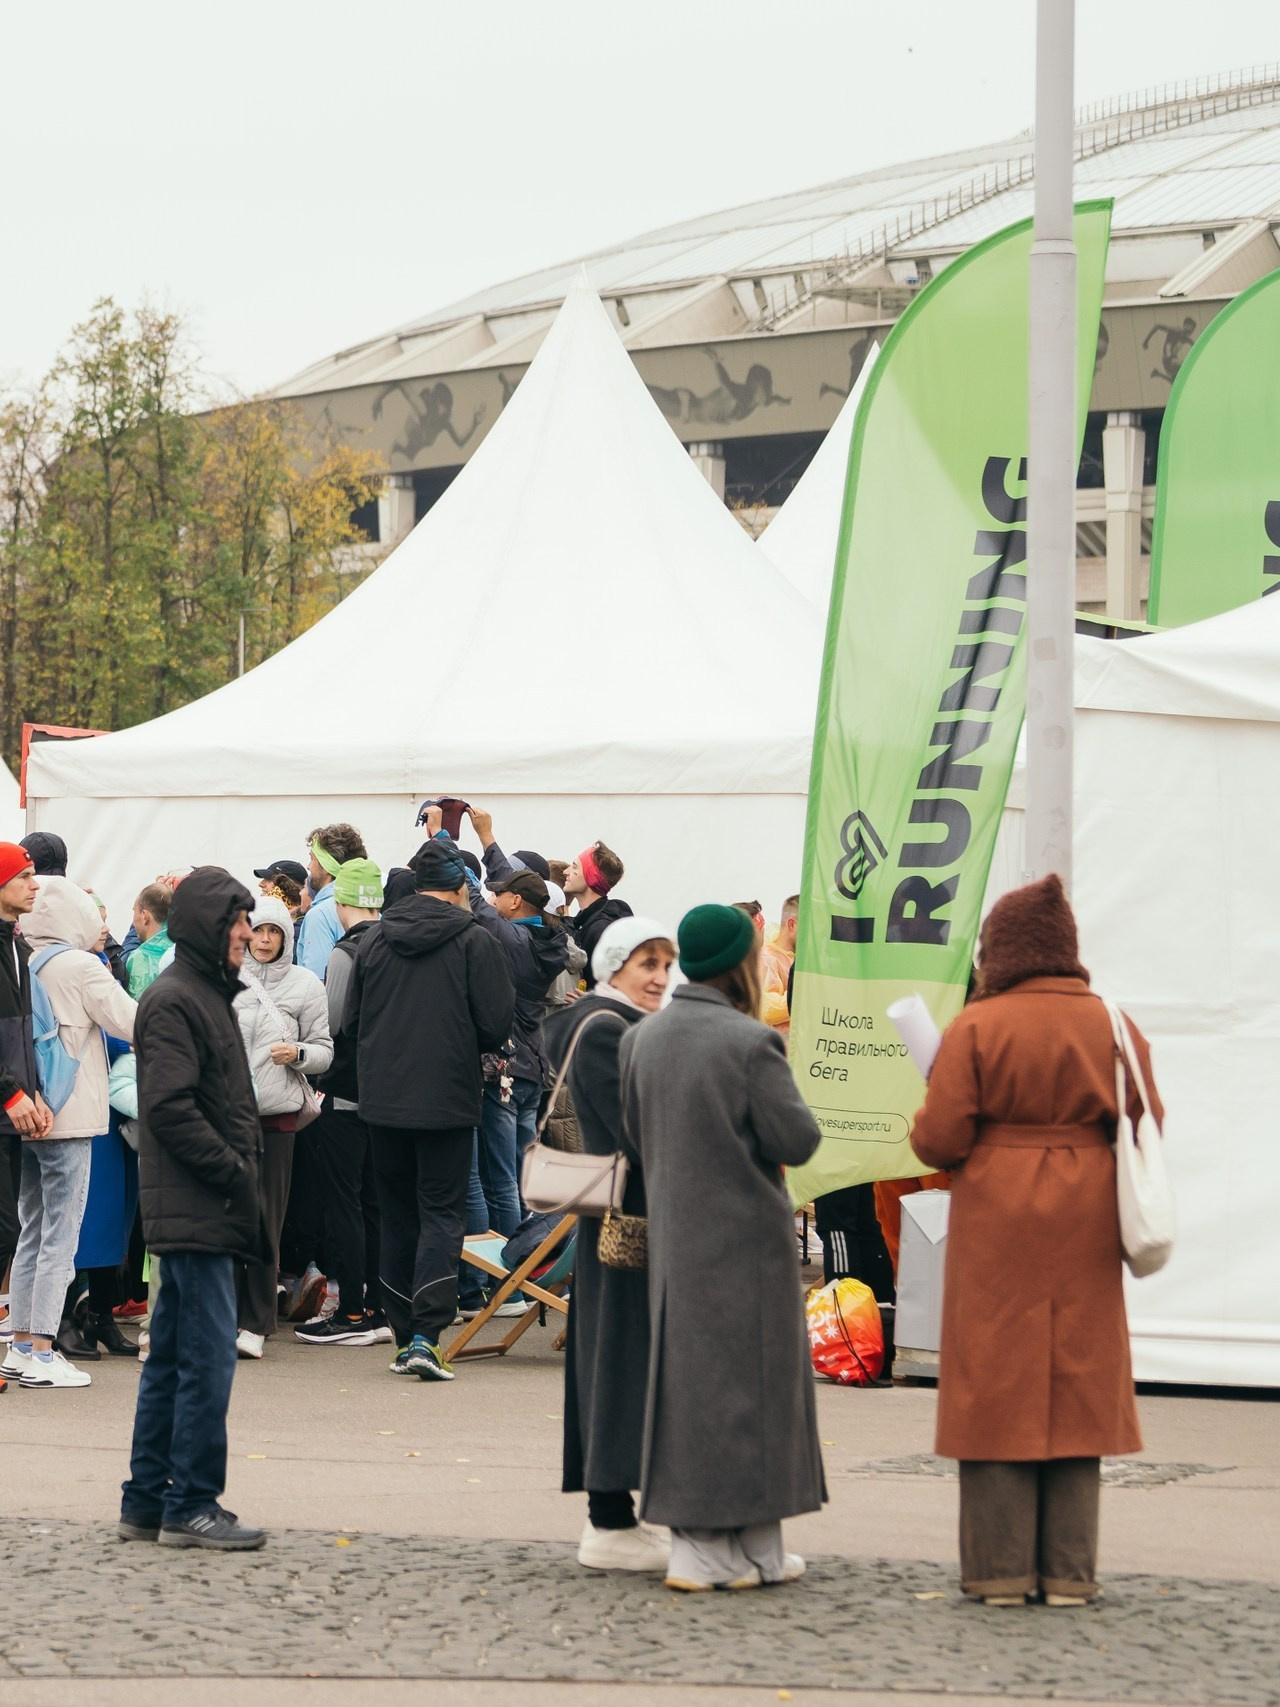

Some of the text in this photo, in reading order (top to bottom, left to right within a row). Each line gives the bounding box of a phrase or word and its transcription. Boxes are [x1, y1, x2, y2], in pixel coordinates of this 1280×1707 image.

[885, 456, 1028, 946] RUNNING
[830, 914, 876, 943] I
[822, 1006, 874, 1030] Школа
[815, 1038, 909, 1058] правильного
[809, 1061, 849, 1082] бега
